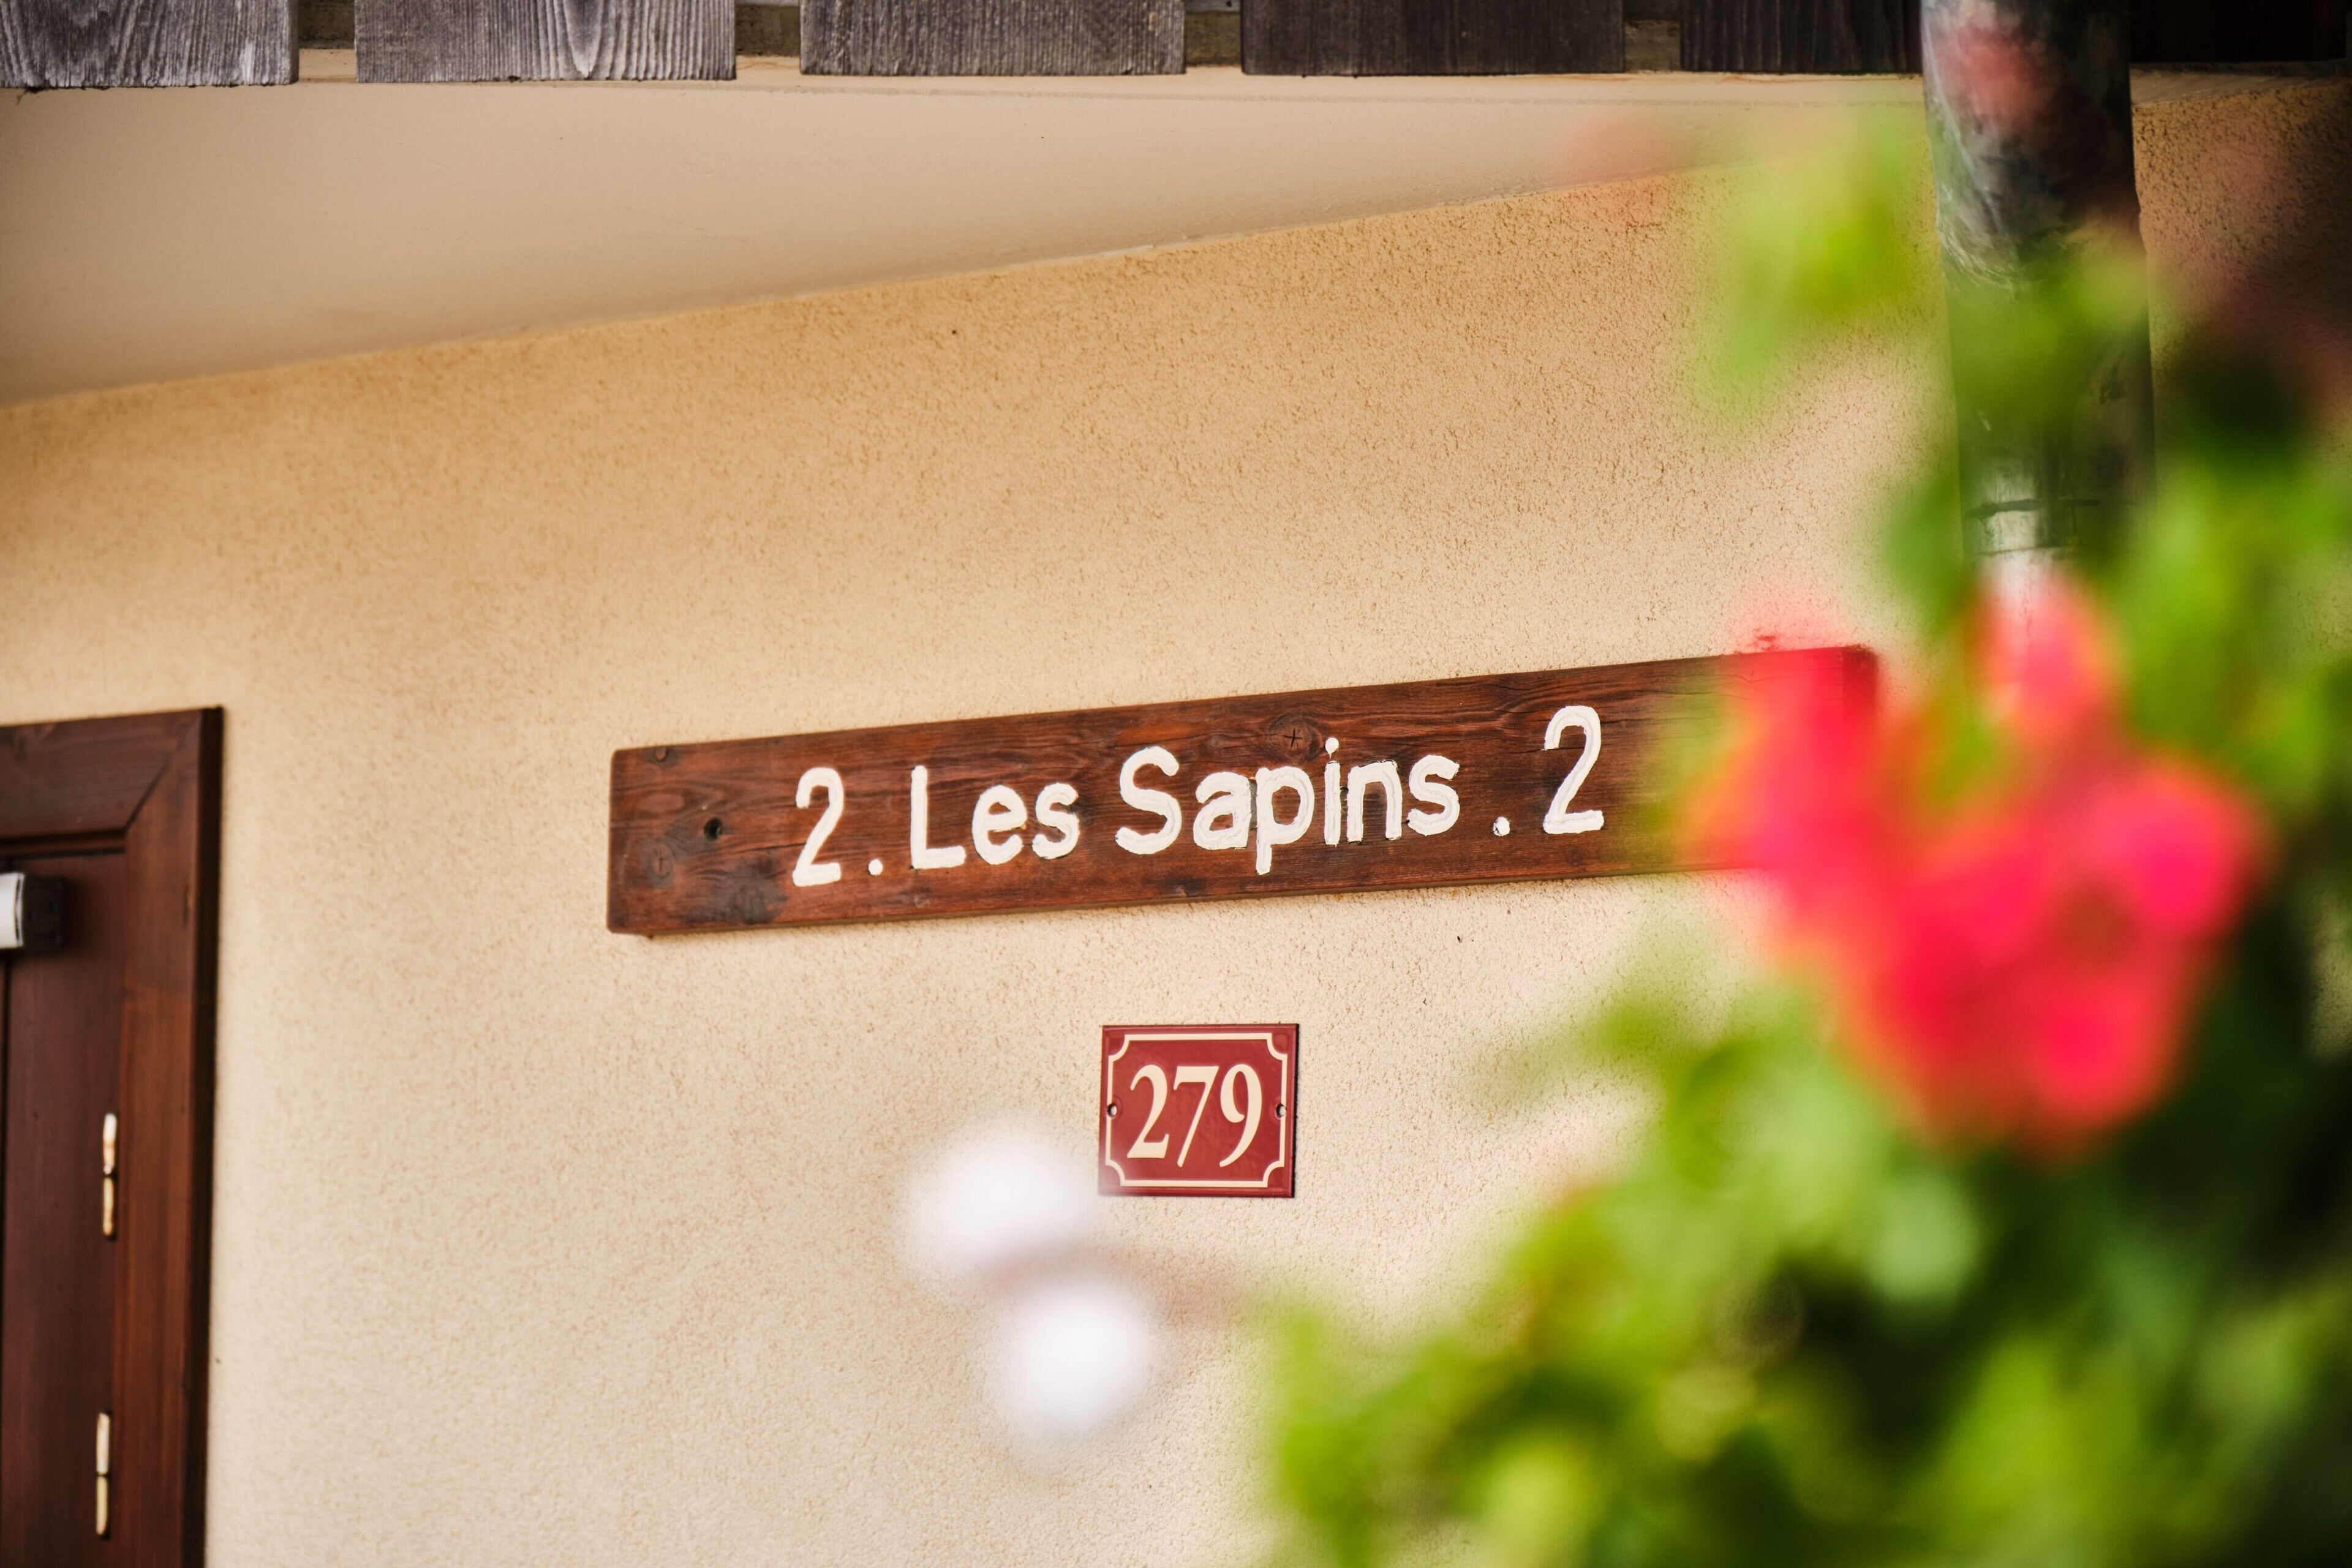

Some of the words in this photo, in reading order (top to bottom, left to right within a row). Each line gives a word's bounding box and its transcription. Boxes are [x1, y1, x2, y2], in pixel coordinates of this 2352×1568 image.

[910, 766, 1079, 869] Les
[1115, 737, 1460, 875] Sapins
[1126, 1063, 1262, 1167] 279
